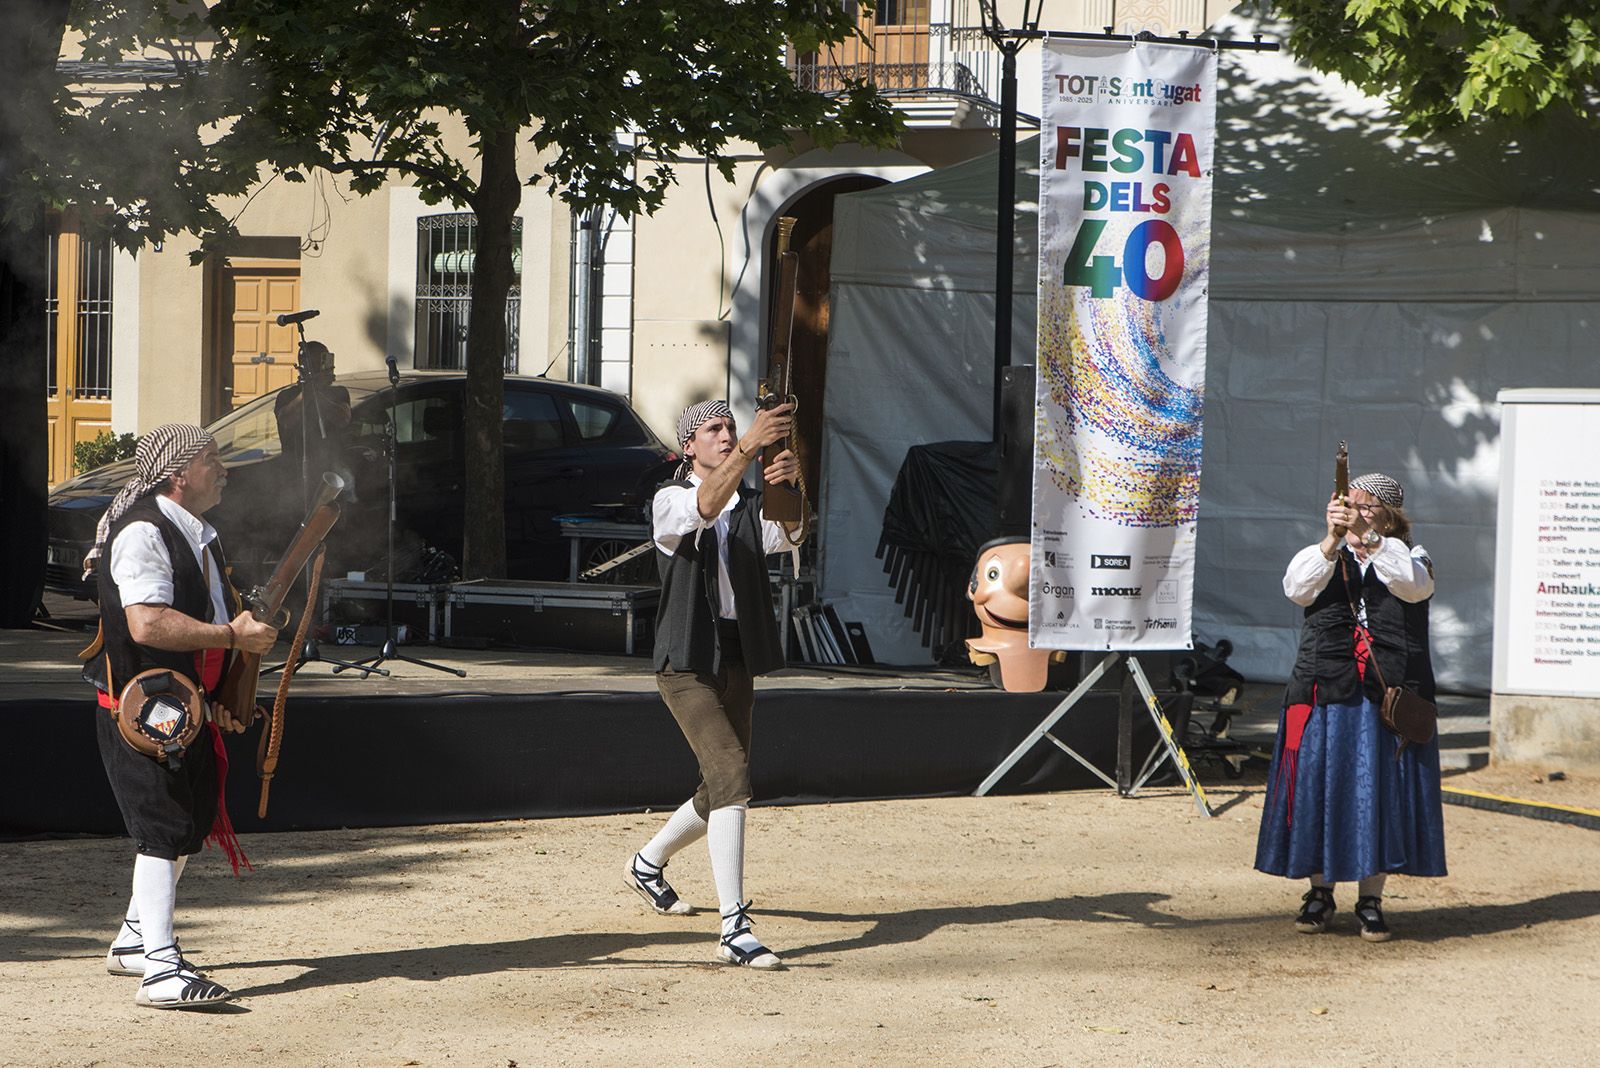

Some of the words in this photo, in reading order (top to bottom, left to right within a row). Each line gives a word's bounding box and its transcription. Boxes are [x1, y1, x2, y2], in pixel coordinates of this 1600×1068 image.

[1055, 74, 1098, 95] TOT
[1059, 95, 1073, 103] 1985
[1077, 96, 1093, 104] 2025
[1108, 98, 1173, 107] ANIVERSARI
[1055, 126, 1201, 178] FESTA
[1083, 181, 1171, 214] DELS
[1063, 219, 1185, 302] 40
[1104, 559, 1129, 567] SOREA
[1091, 587, 1142, 596] moonz
